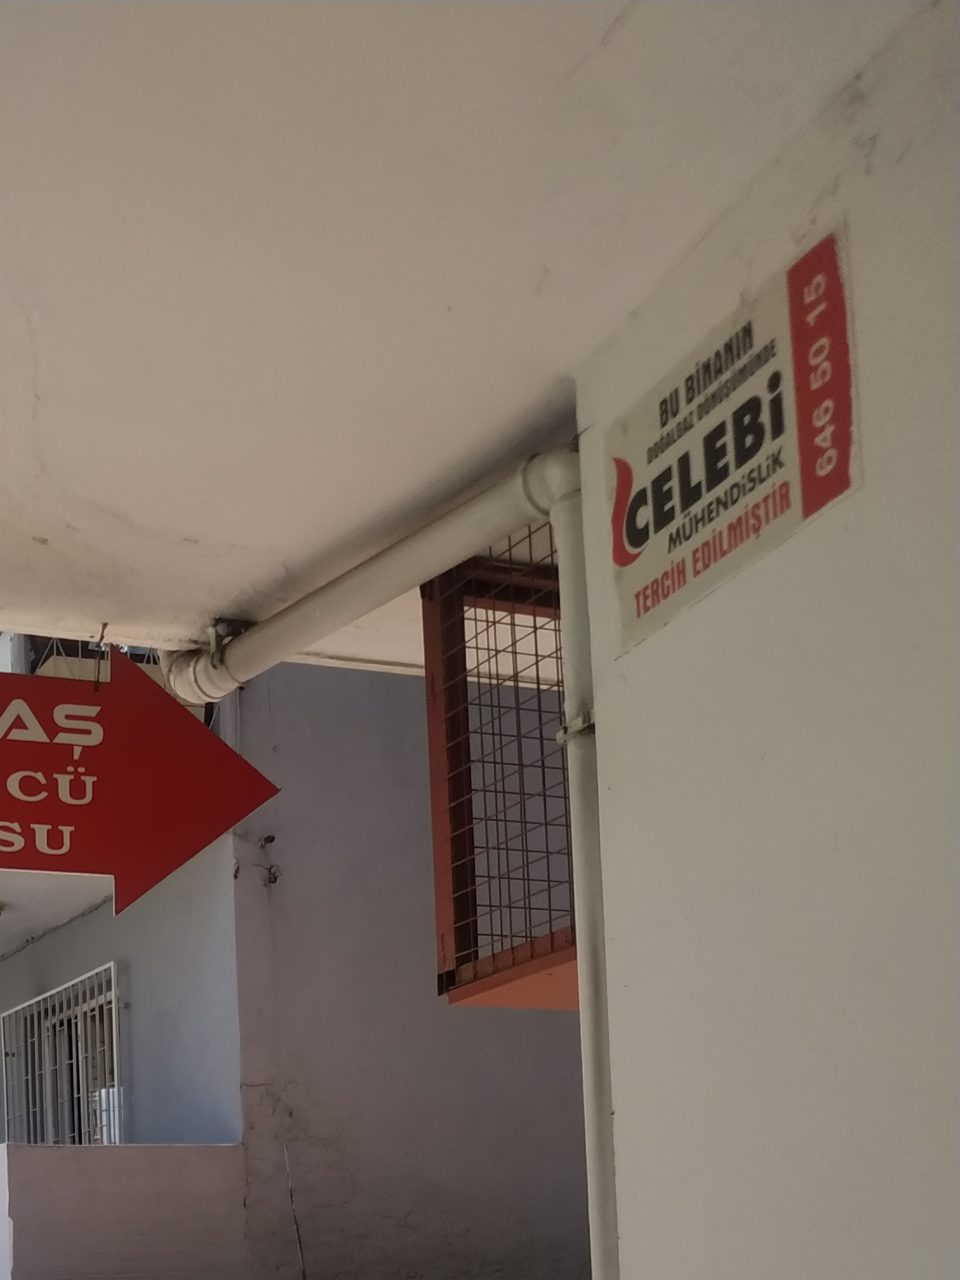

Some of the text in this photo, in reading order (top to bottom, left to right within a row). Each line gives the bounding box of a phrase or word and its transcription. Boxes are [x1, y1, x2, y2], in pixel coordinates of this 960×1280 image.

[659, 320, 754, 429] BU BİNANIN
[803, 272, 839, 477] 646 50 15
[633, 479, 793, 619] TERCİH EDİLMİŞTİR
[667, 445, 785, 555] MÜHENDİSLİK
